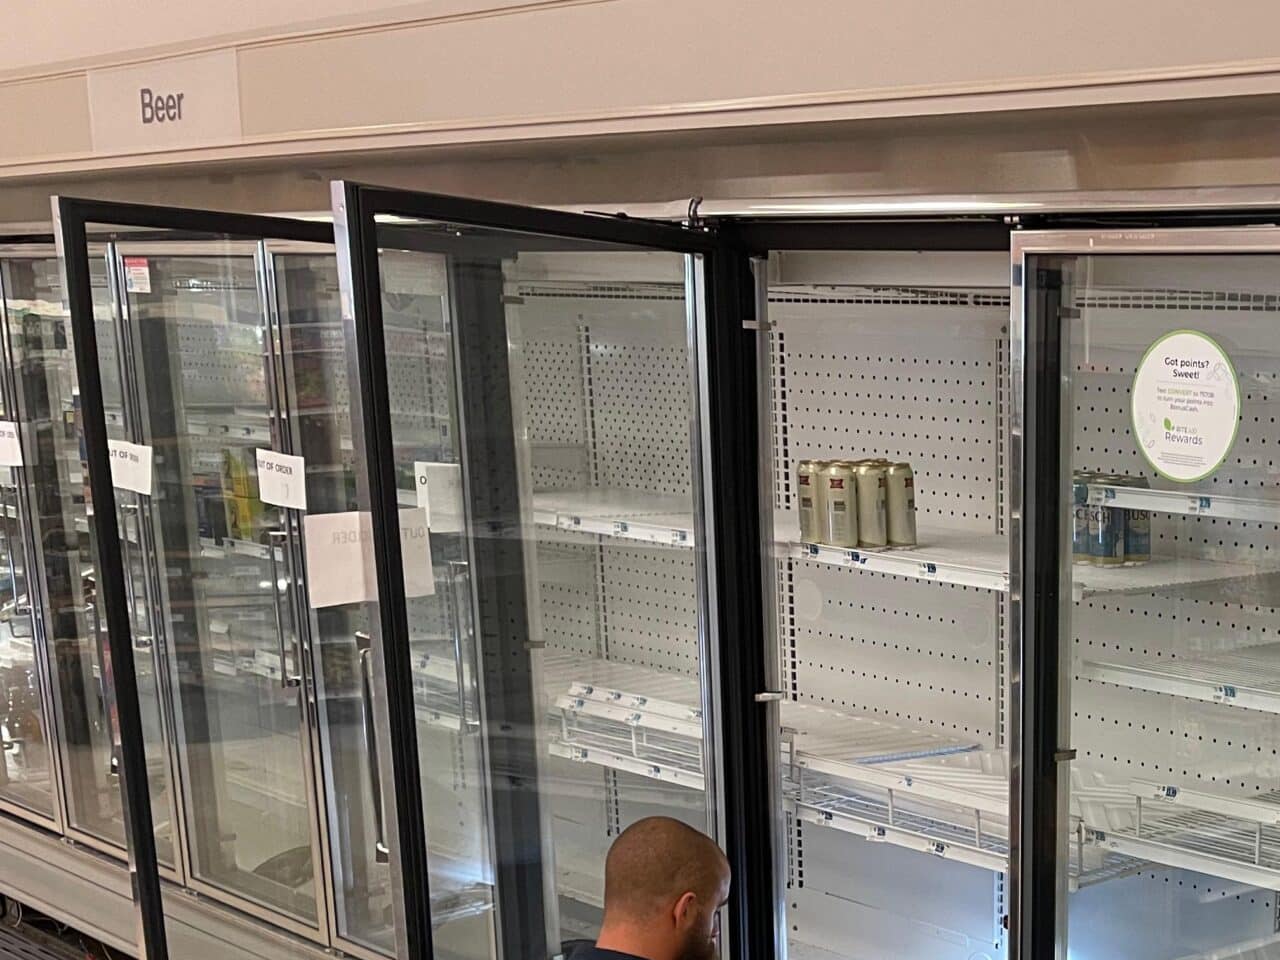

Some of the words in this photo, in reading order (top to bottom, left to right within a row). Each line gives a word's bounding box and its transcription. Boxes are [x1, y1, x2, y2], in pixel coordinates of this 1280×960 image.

[140, 88, 184, 124] Beer
[1164, 356, 1178, 367] Got
[1180, 358, 1210, 369] points?
[1172, 368, 1200, 380] Sweet!
[1164, 431, 1203, 445] Rewards
